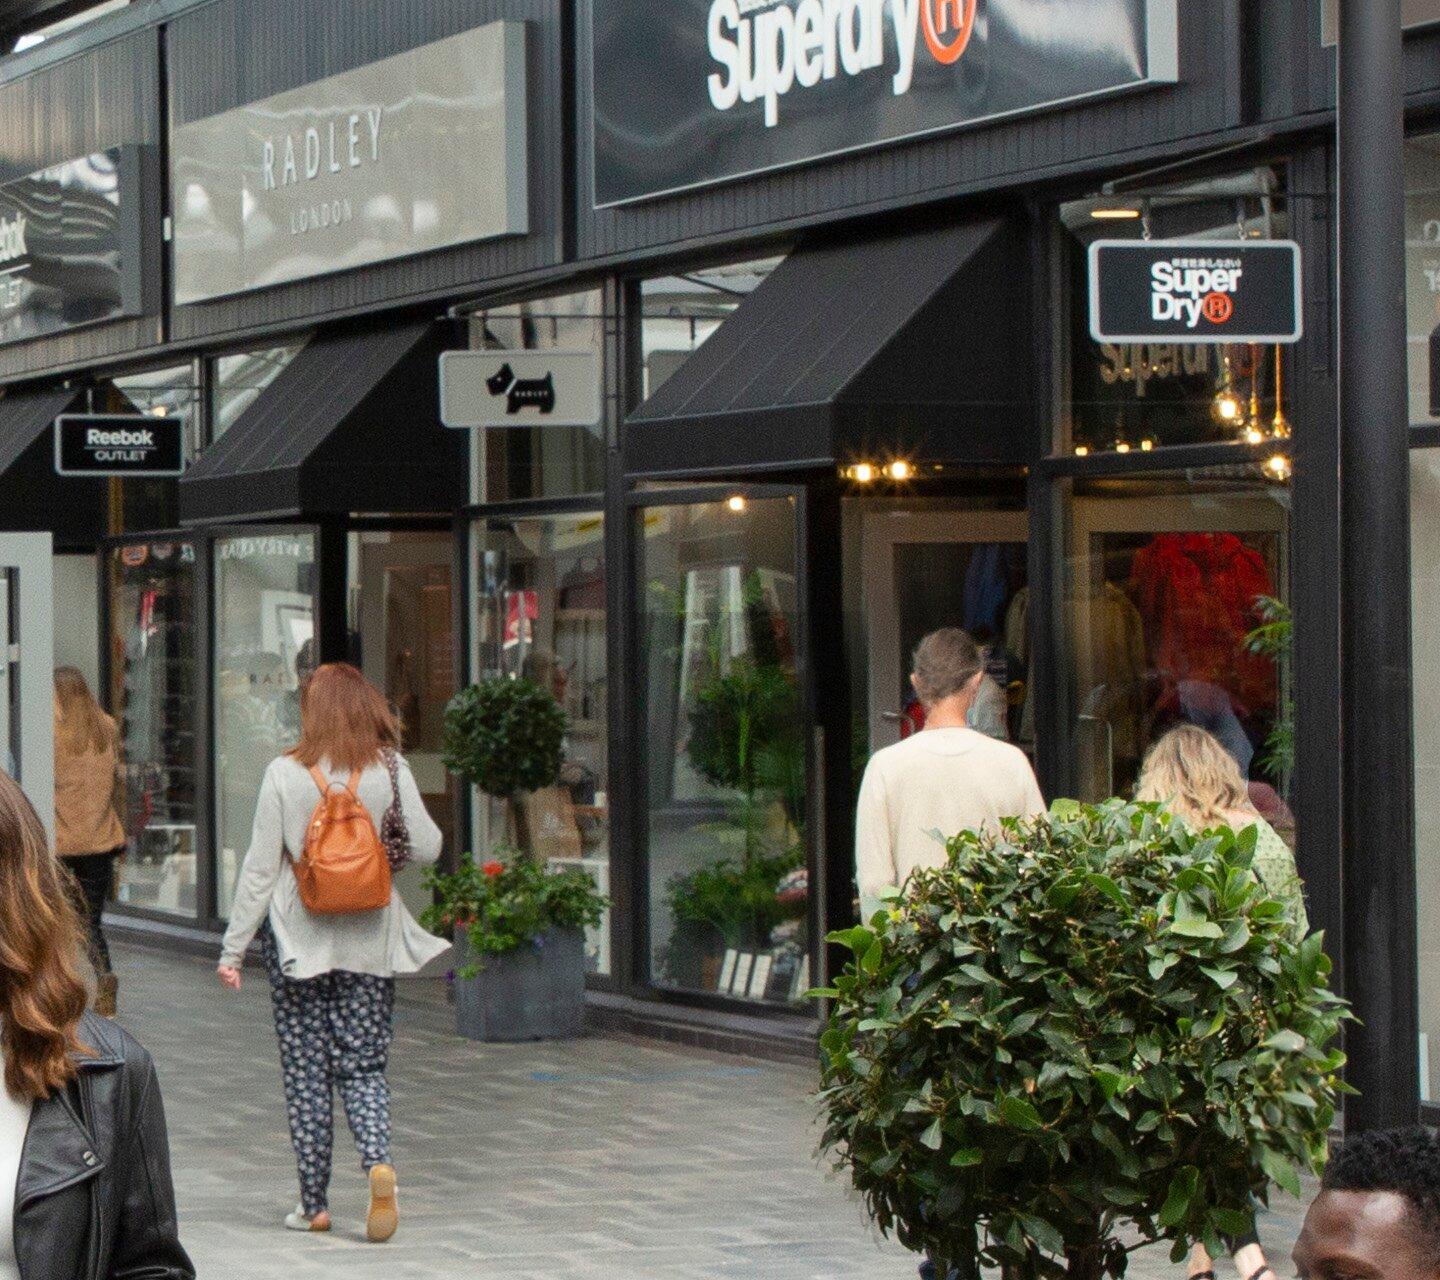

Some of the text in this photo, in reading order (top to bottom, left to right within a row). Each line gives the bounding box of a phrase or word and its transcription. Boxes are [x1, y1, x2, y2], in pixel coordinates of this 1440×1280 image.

[264, 108, 382, 191] RADLEY
[291, 198, 353, 235] LONDON
[1151, 261, 1243, 299] Super
[1151, 292, 1204, 328] Dry
[86, 428, 154, 446] Reebok
[94, 450, 148, 462] OUTLET
